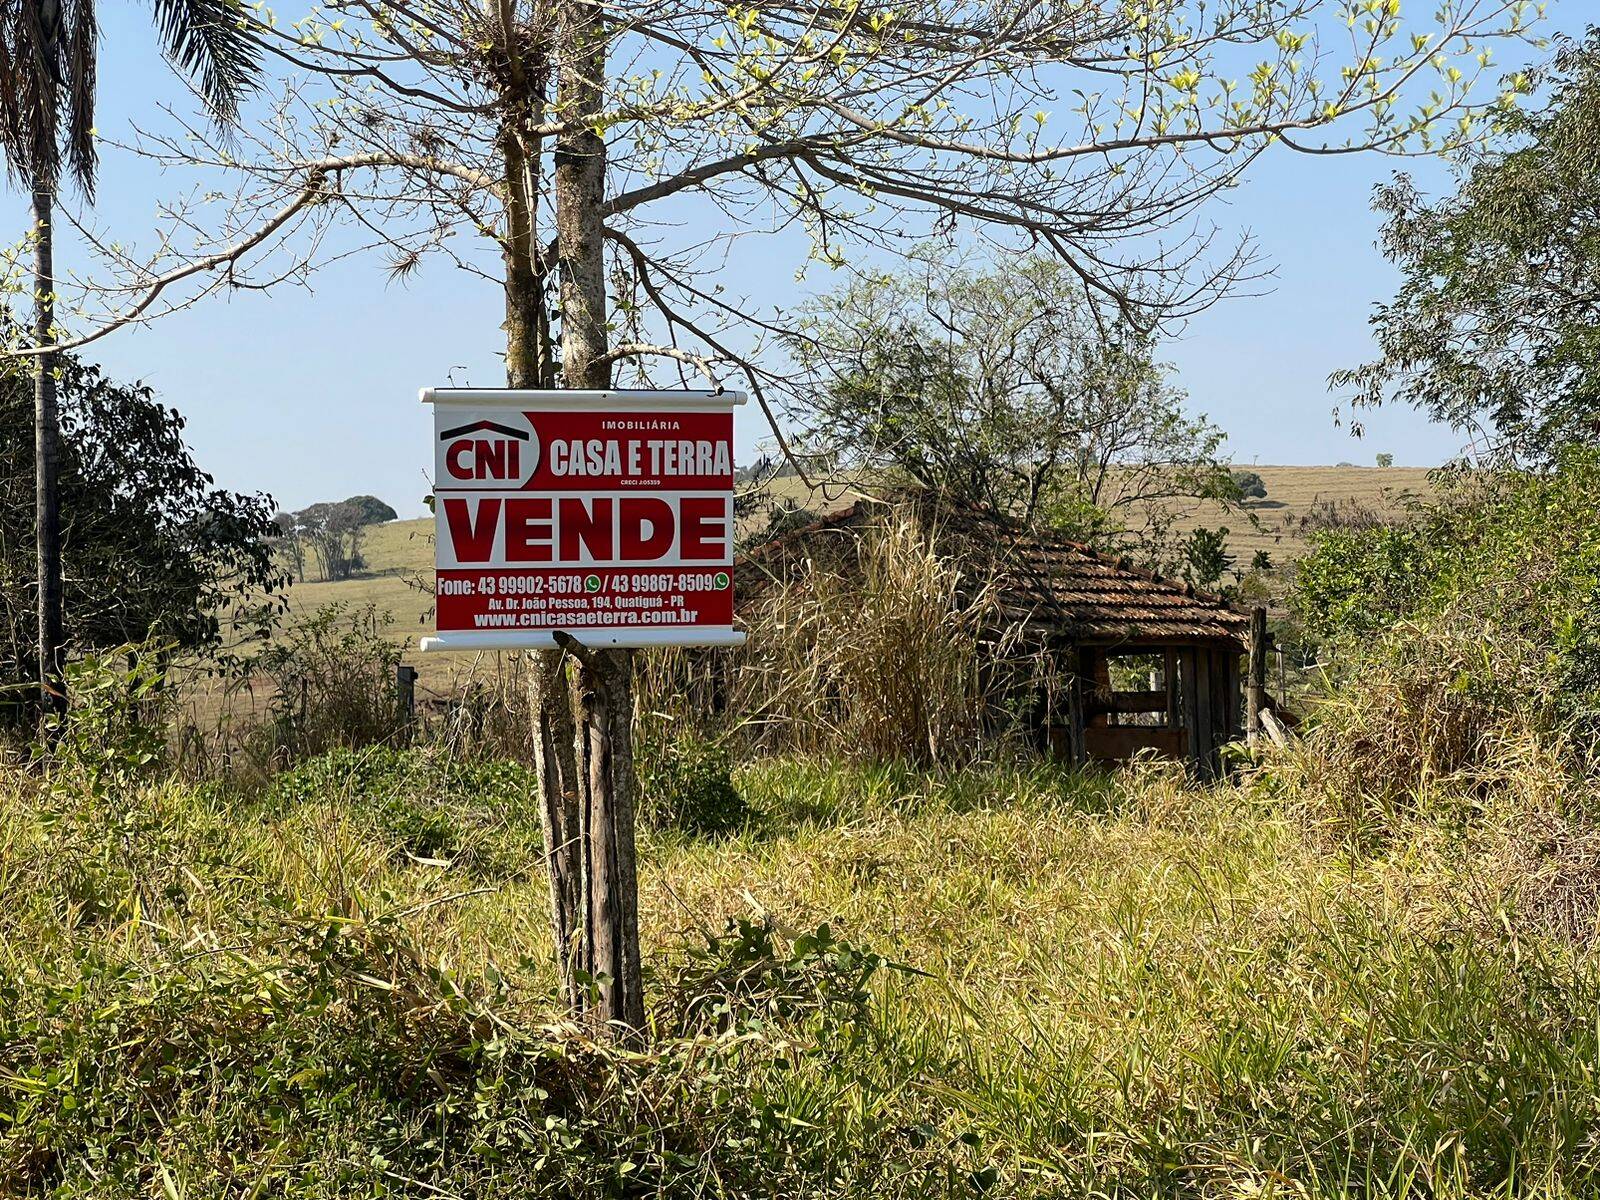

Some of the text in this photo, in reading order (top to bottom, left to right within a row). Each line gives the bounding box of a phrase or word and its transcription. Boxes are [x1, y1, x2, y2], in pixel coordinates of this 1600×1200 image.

[602, 419, 680, 430] IMOBILIÁRIA
[446, 439, 520, 480] CNI
[550, 439, 731, 476] CASA E TERRA
[442, 497, 726, 562] VENDE
[437, 577, 475, 595] Fone:
[477, 576, 496, 595] 43
[498, 575, 582, 594] 99902-5678
[611, 575, 629, 592] 43
[631, 574, 713, 592] 99867-8509
[488, 598, 504, 610] Av.
[505, 598, 520, 609] Dr.
[521, 597, 547, 609] João
[548, 597, 590, 609] Pessoa,
[591, 596, 613, 609] 194,
[614, 595, 663, 609] Quatiguá
[670, 595, 684, 607] PR
[474, 608, 698, 627] www.cnicasaeterra.com.br
